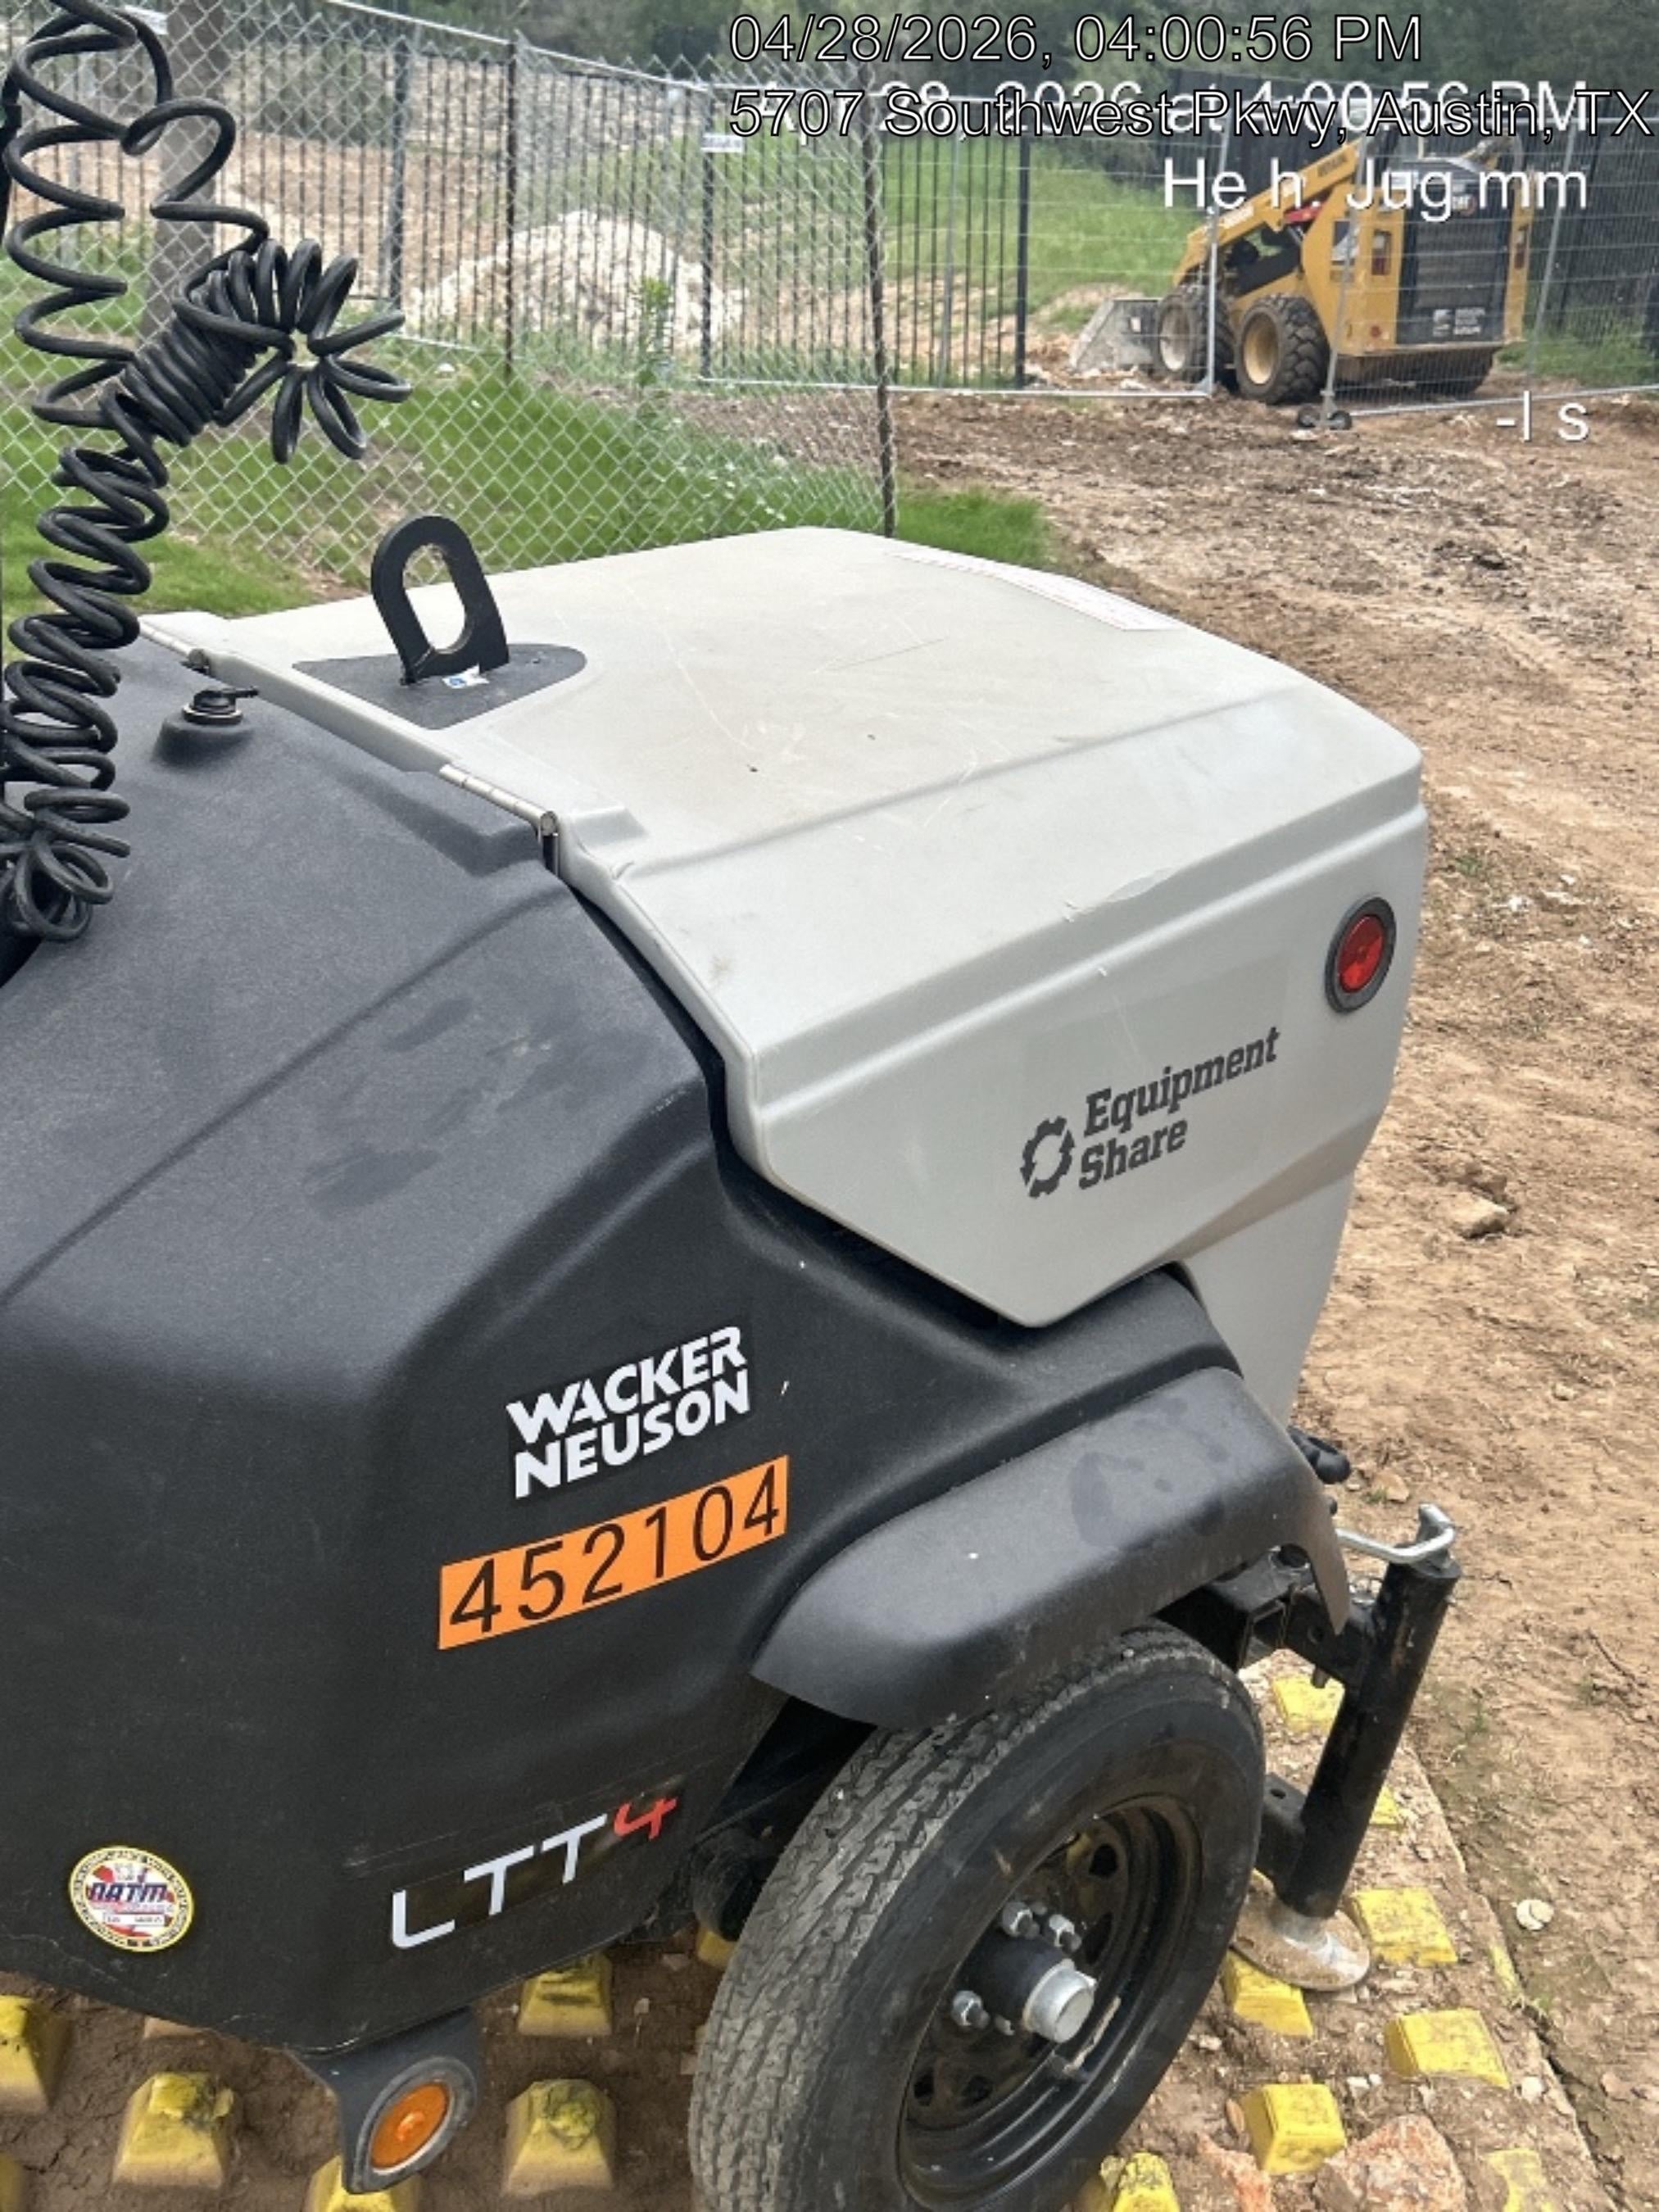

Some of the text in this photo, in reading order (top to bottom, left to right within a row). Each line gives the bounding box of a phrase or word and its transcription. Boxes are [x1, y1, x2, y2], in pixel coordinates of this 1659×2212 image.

[1083, 1026, 1281, 1138] Equipment
[1078, 1118, 1188, 1190] Share
[505, 1326, 748, 1444] WACKER
[514, 1368, 750, 1499] NEUSON
[449, 1463, 779, 1634] 452104
[392, 1796, 678, 1951] LTT4
